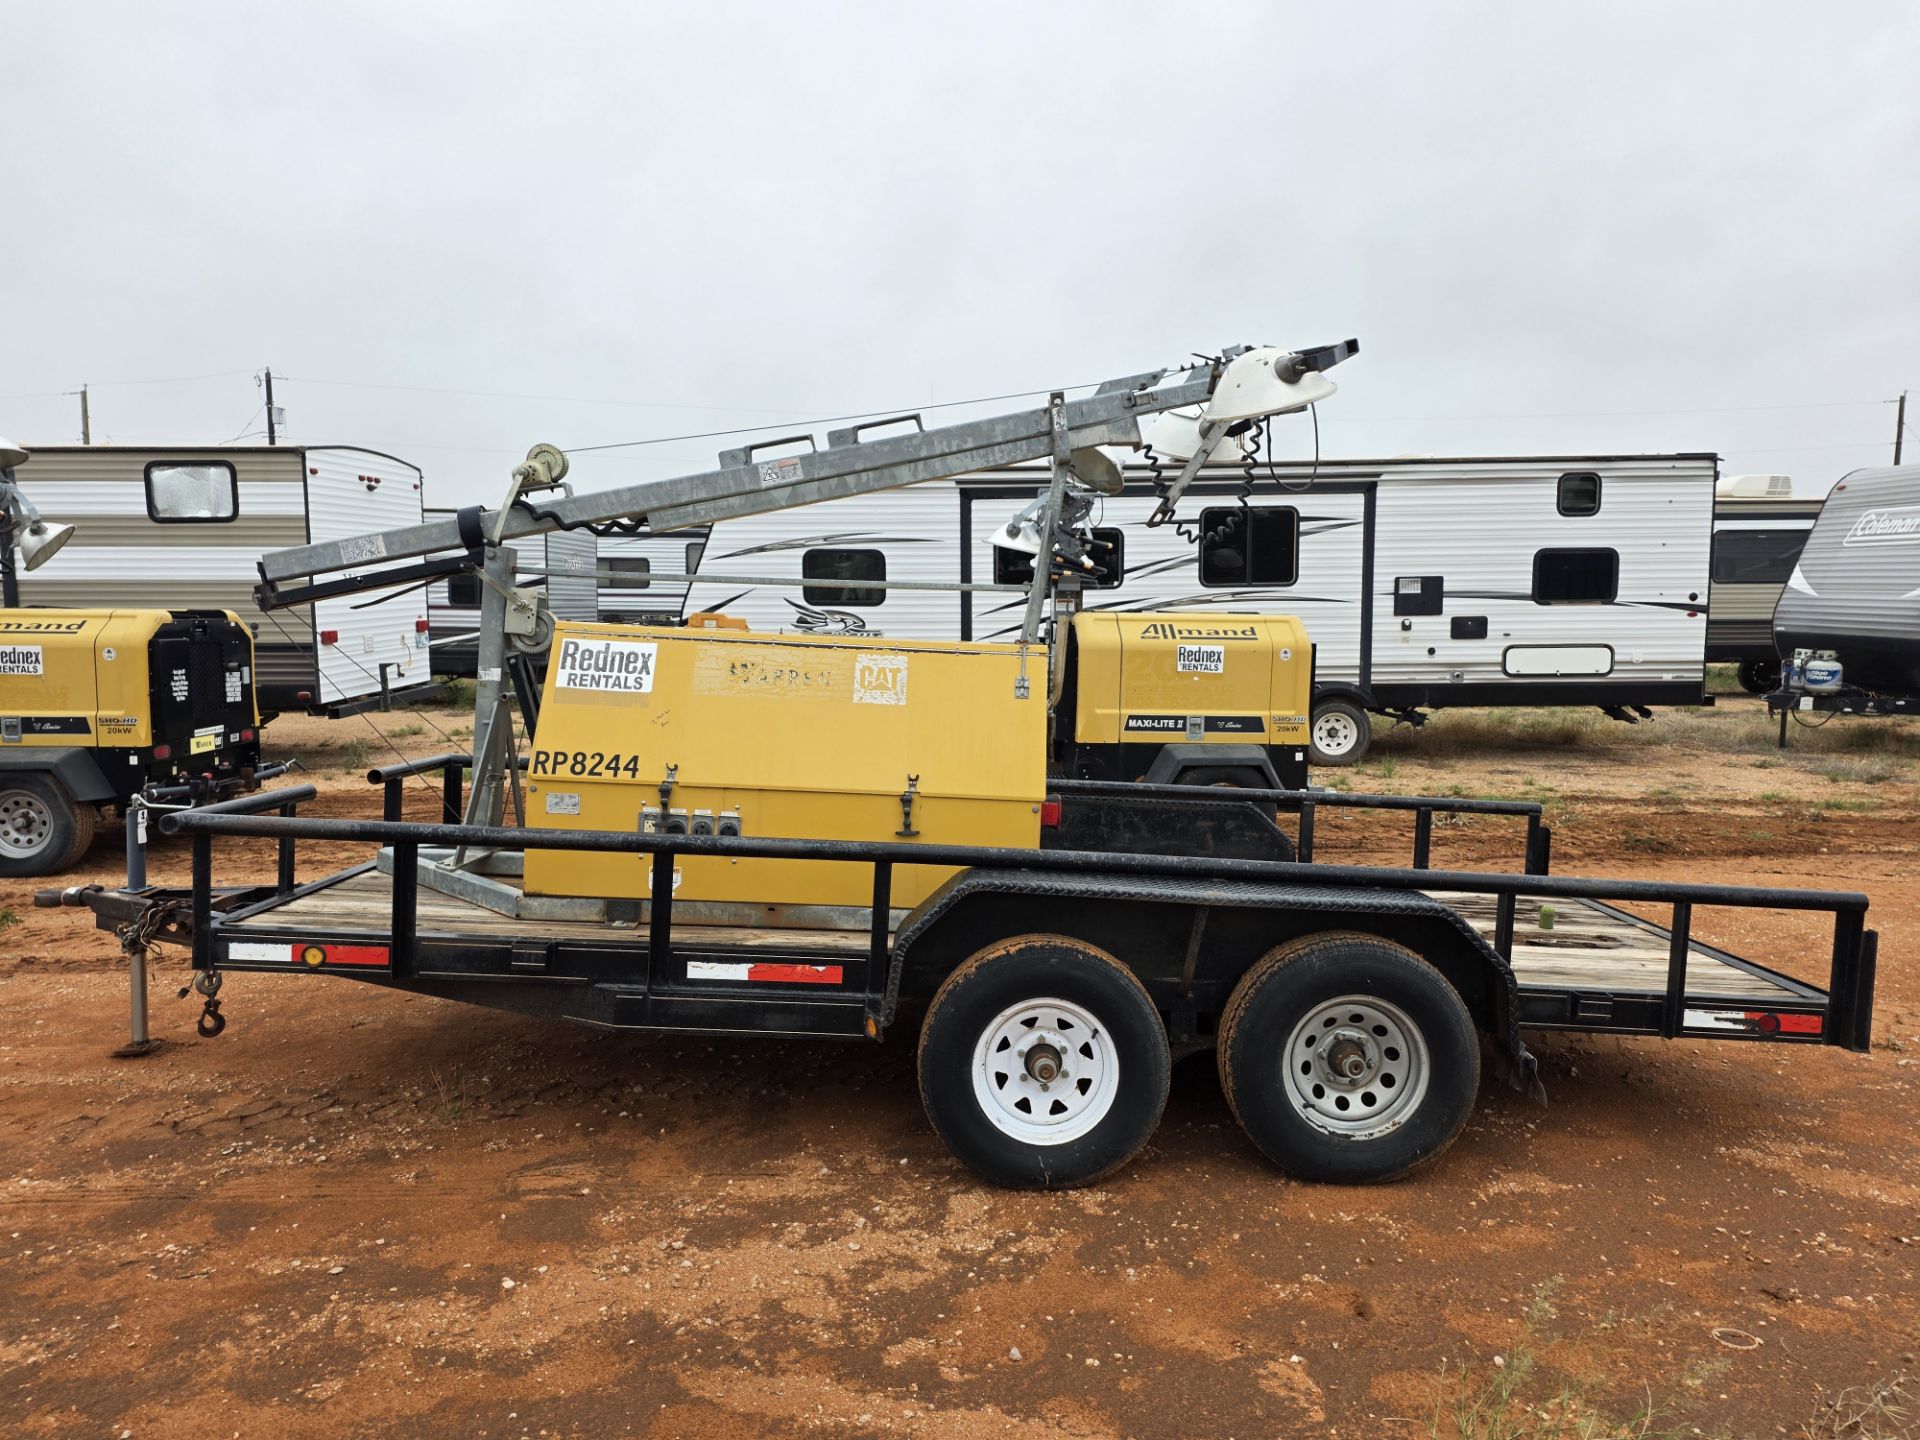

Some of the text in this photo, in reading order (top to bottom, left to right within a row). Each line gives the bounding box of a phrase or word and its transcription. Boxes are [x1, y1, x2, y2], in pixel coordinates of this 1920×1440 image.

[1856, 513, 1920, 535] Coleman
[1141, 624, 1257, 640] Allmand
[560, 640, 653, 675] Rednex
[1178, 646, 1222, 663] Rednex
[1183, 663, 1219, 671] RENTALS
[567, 673, 643, 690] RENTALS
[859, 664, 900, 692] CAT
[106, 727, 132, 735] 20kW
[1128, 719, 1175, 729] MAXI-LITE
[1276, 725, 1300, 733] 20kW
[532, 750, 640, 779] RP8244
